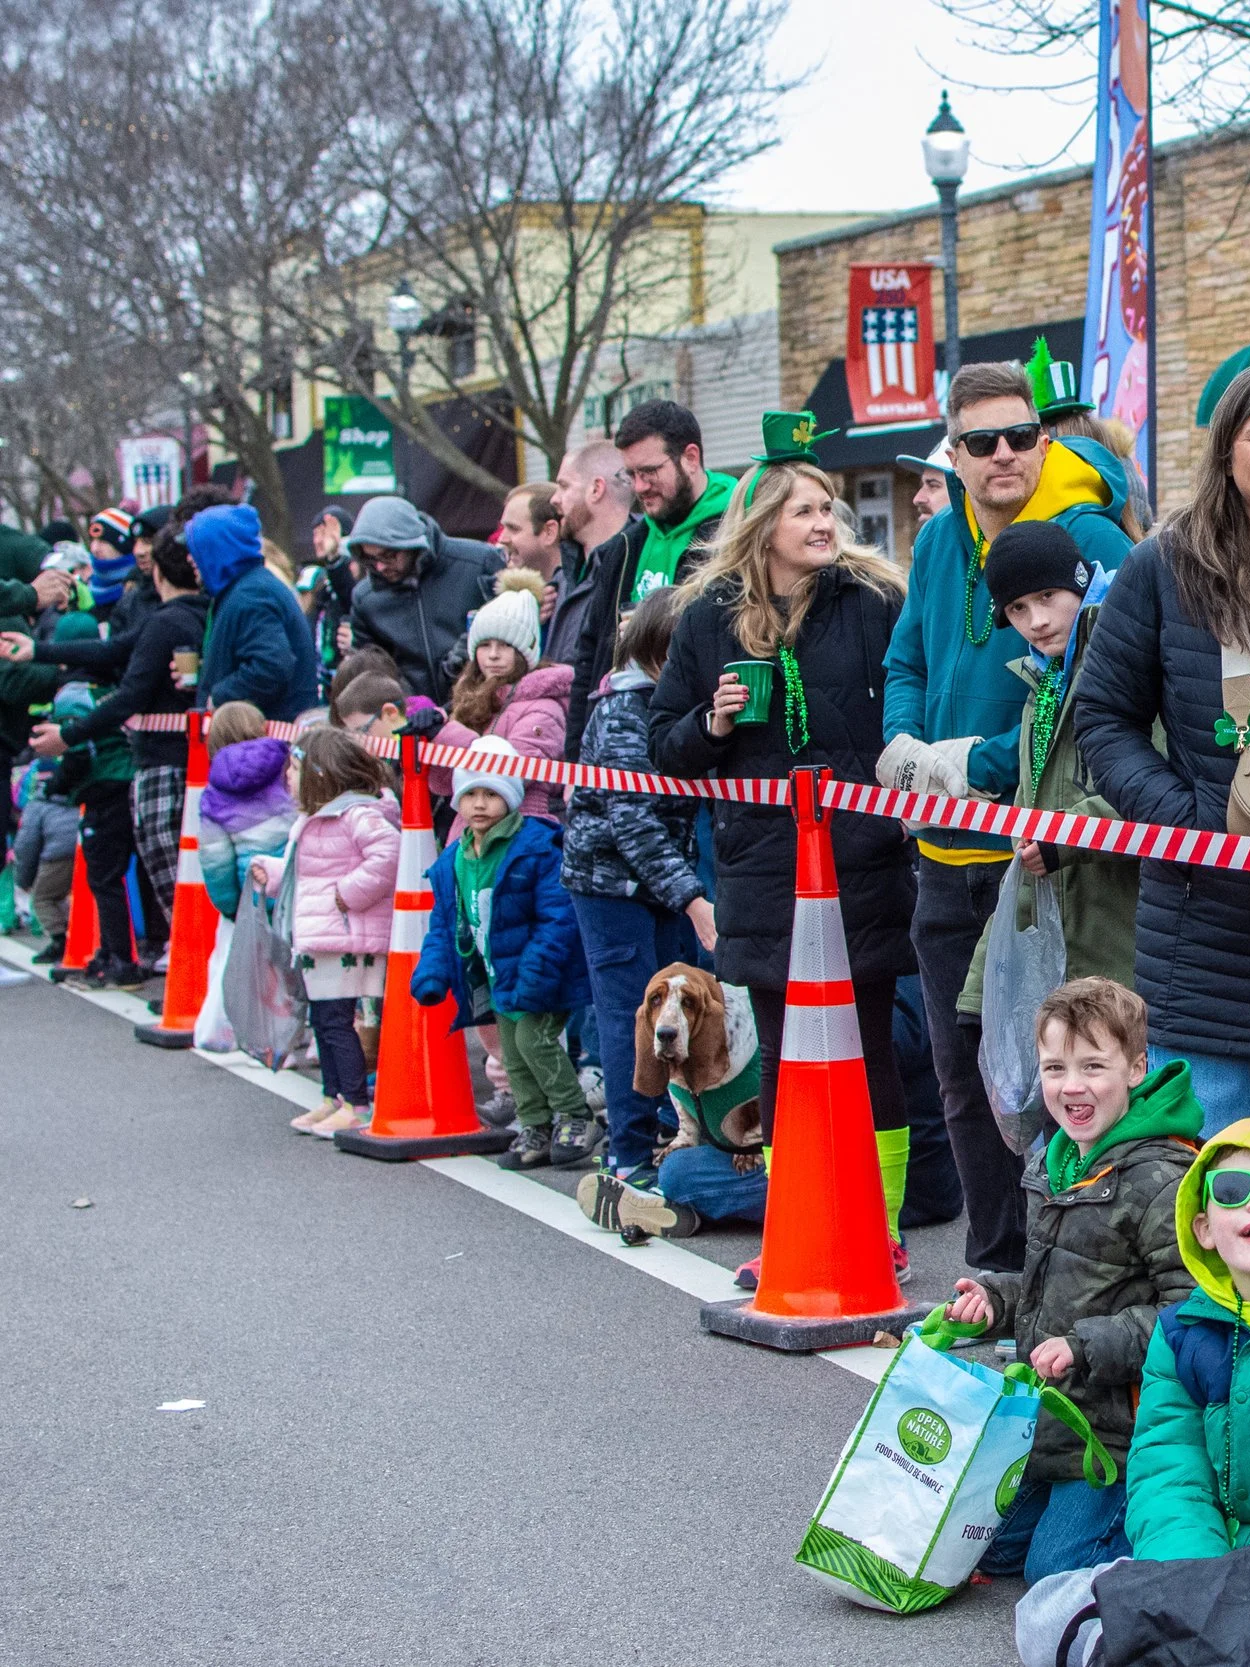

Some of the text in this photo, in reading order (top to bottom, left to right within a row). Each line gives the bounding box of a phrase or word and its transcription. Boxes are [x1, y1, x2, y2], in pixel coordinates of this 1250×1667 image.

[869, 269, 911, 291] USA
[339, 427, 389, 449] Shop
[906, 1419, 945, 1450] NATURE
[917, 1412, 945, 1437] OPEN
[874, 1442, 944, 1494] FOOD SHOULD BE SIMPLE
[962, 1524, 985, 1540] FOOD
